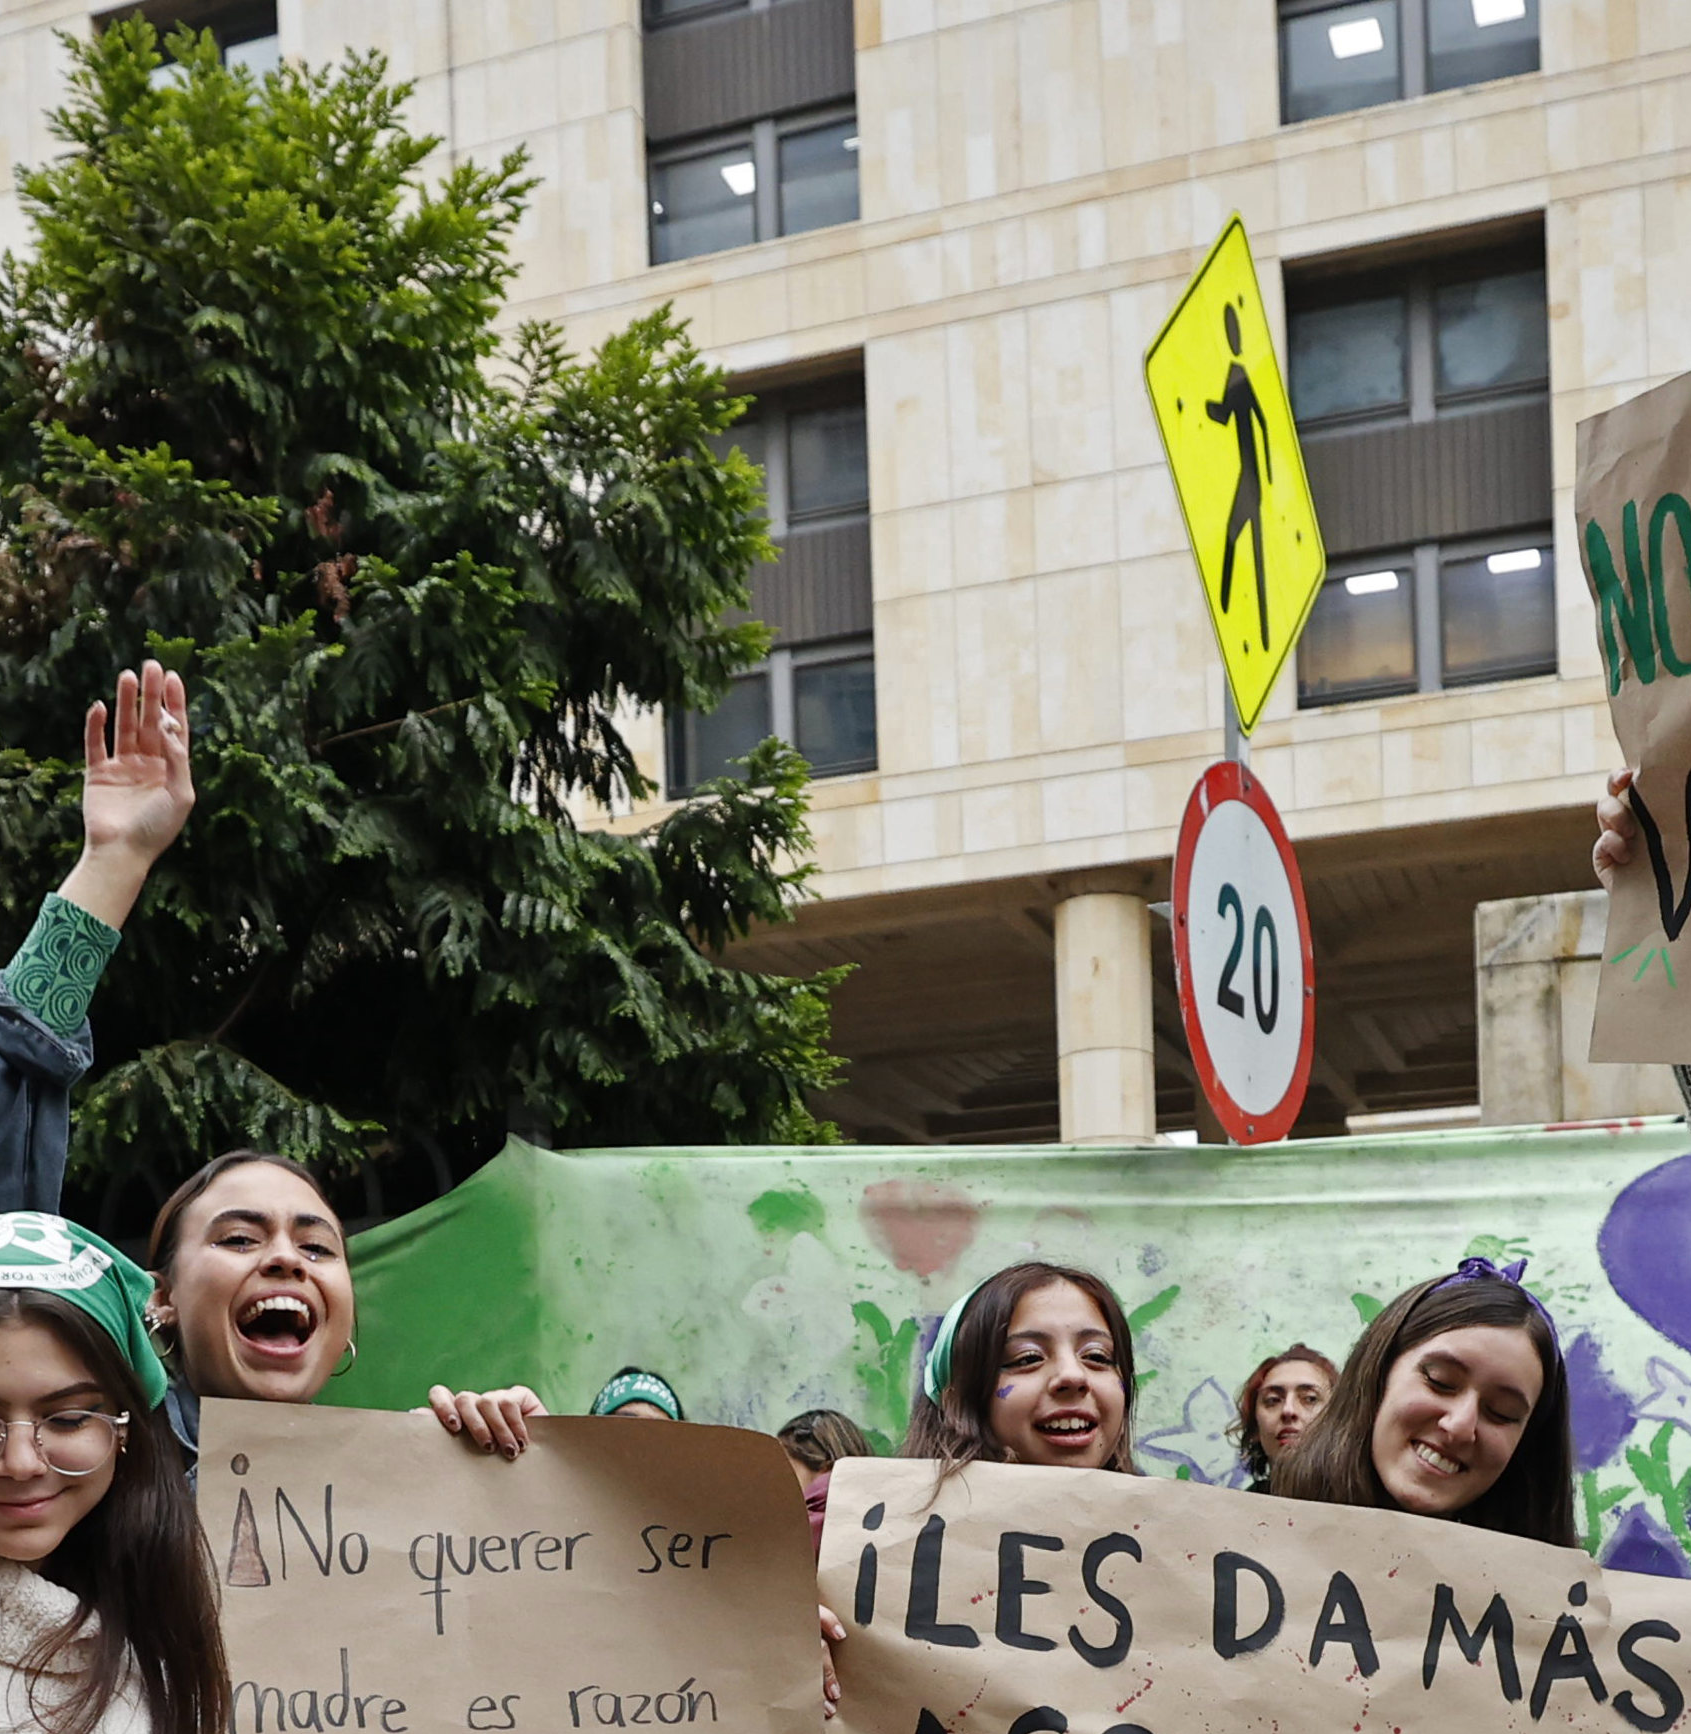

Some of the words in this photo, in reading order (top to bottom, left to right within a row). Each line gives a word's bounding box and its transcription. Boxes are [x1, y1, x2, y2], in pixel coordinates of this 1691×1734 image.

[1216, 882, 1280, 1036] 20
[2, 1271, 35, 1281] POR
[226, 1453, 369, 1587] ¡No
[409, 1528, 592, 1635] querer
[853, 1500, 1143, 1668] ¡LES
[1210, 1552, 1374, 1680] DA
[1422, 1578, 1684, 1734] MÁS
[467, 1693, 521, 1730] es
[569, 1677, 718, 1727] razón
